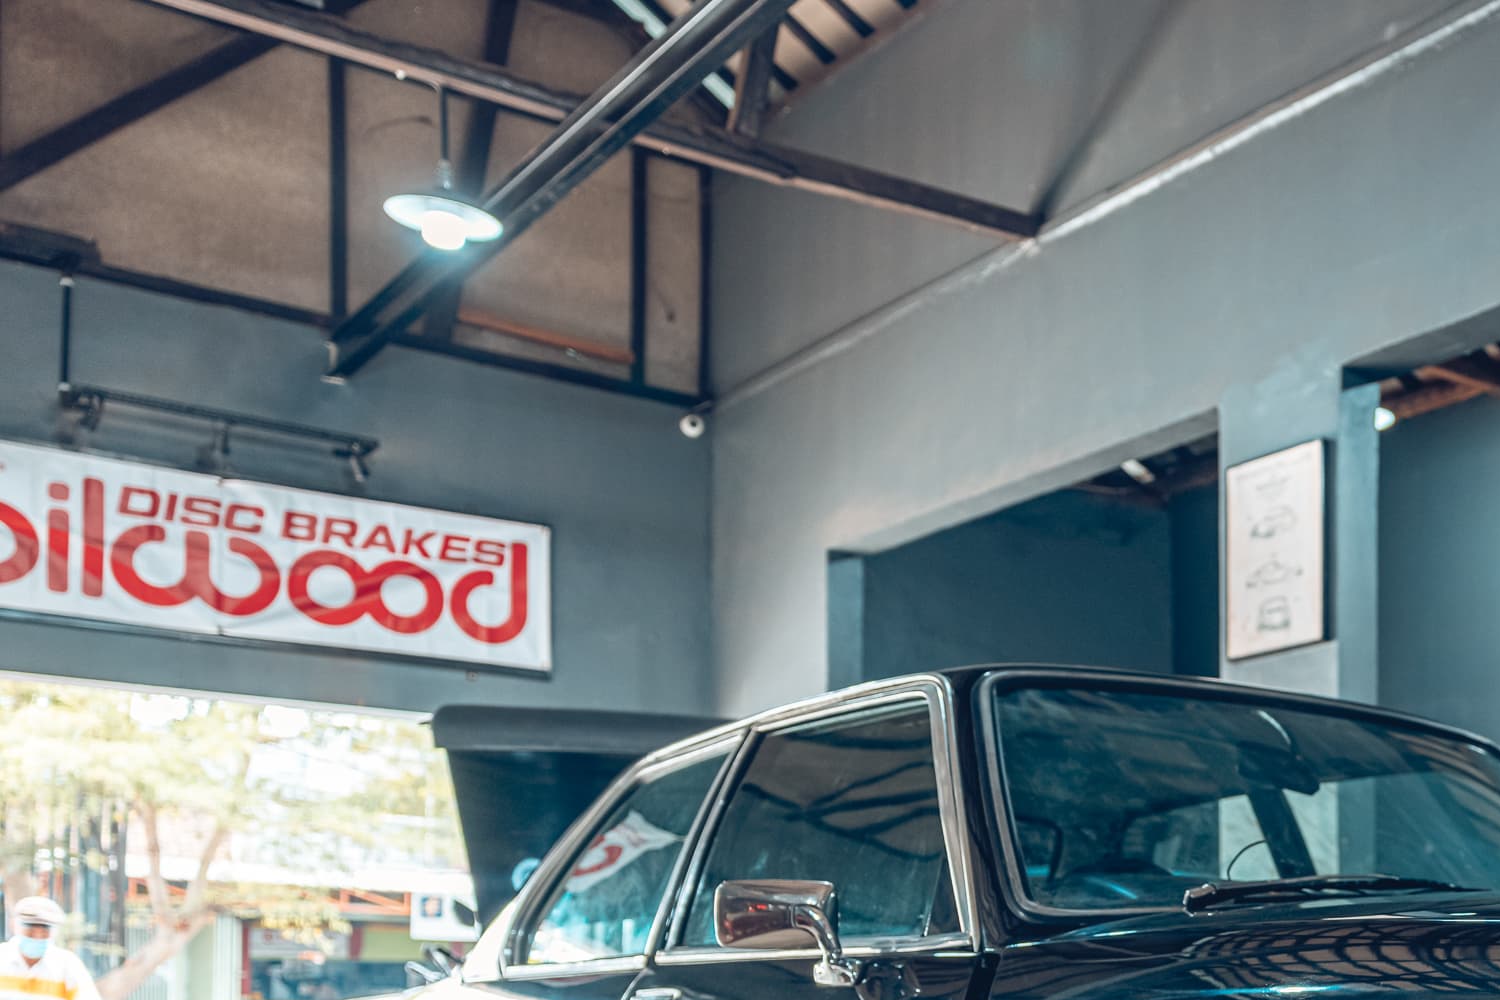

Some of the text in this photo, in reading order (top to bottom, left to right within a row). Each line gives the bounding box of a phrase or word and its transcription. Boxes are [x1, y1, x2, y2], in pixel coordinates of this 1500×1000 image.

[0, 476, 528, 644] ilwood
[117, 485, 507, 567] DISC BRAKES
